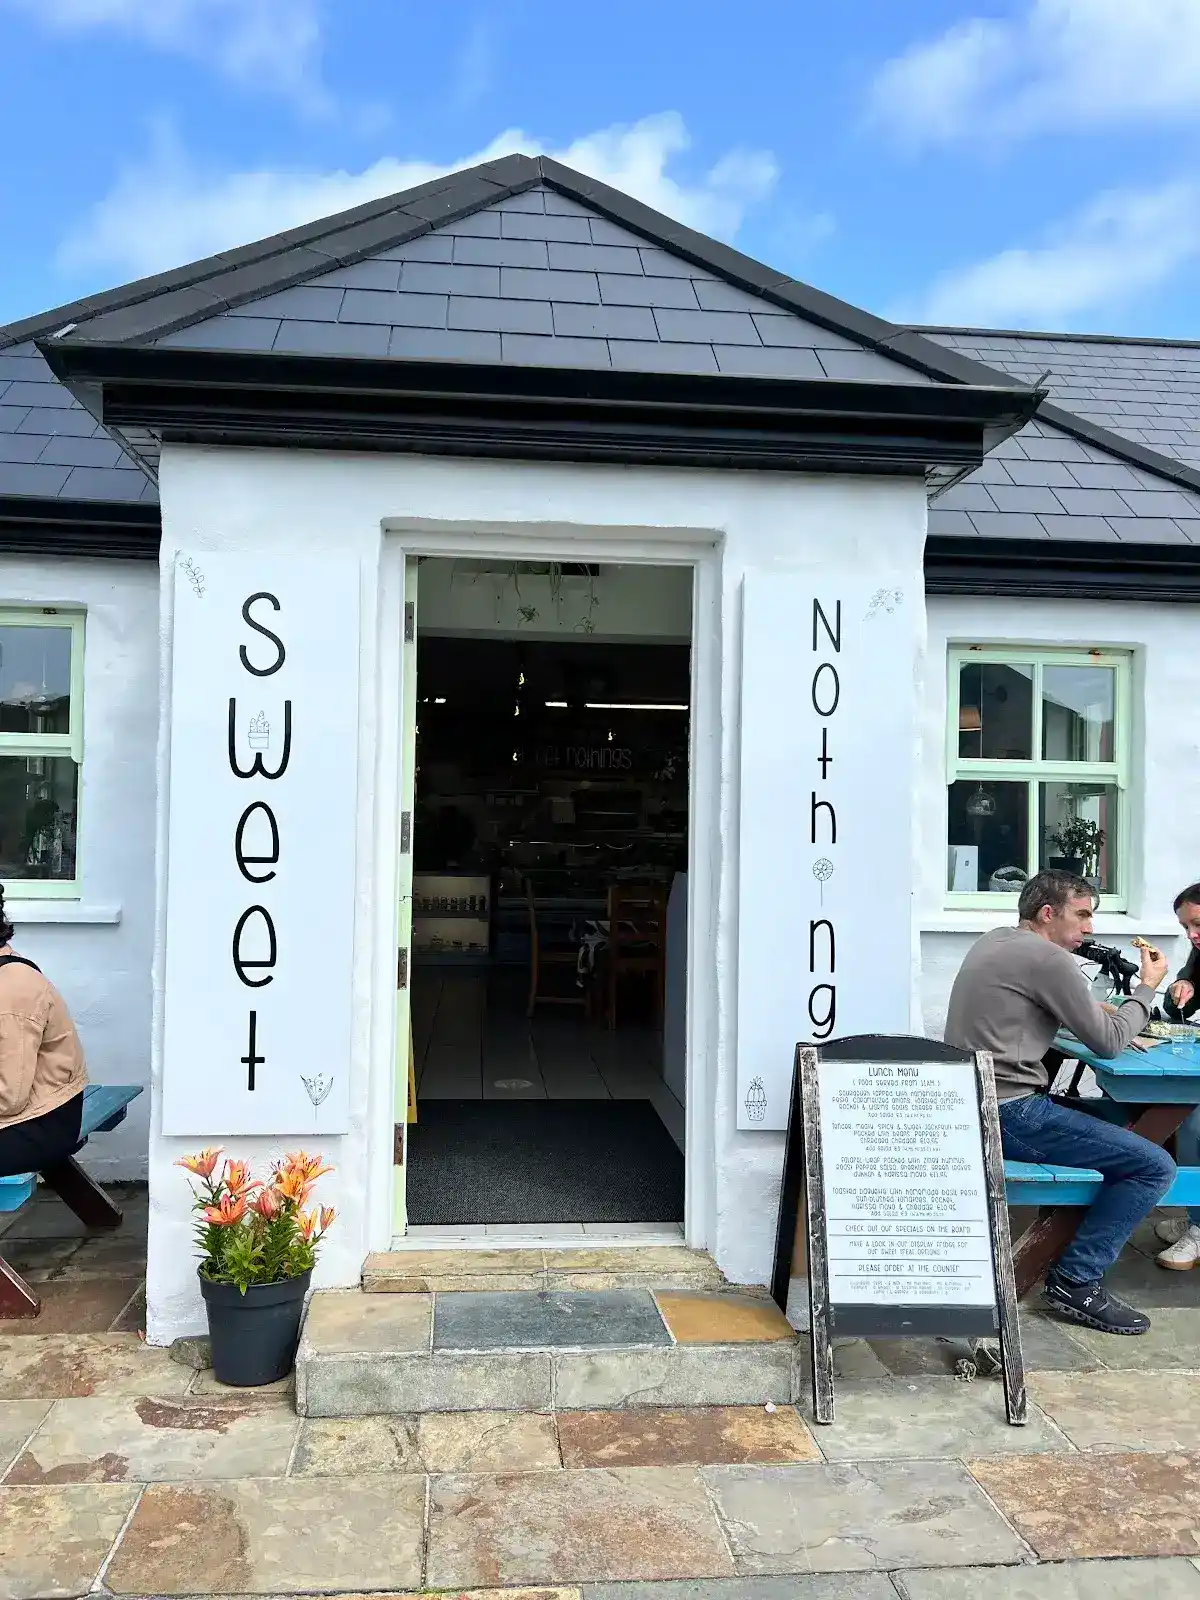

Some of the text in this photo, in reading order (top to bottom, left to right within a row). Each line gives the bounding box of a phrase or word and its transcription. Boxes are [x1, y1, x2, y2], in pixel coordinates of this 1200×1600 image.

[227, 591, 292, 1092] Sweet
[868, 1067, 919, 1077] Lunch Menu
[844, 1224, 865, 1232] CHECK
[867, 1224, 879, 1232] OUT
[895, 1225, 924, 1233] SPECIALS
[926, 1225, 935, 1233] ON
[938, 1225, 949, 1233] THE
[858, 1264, 881, 1272] PLEASE
[908, 1264, 915, 1272] AT
[918, 1264, 930, 1272] THE
